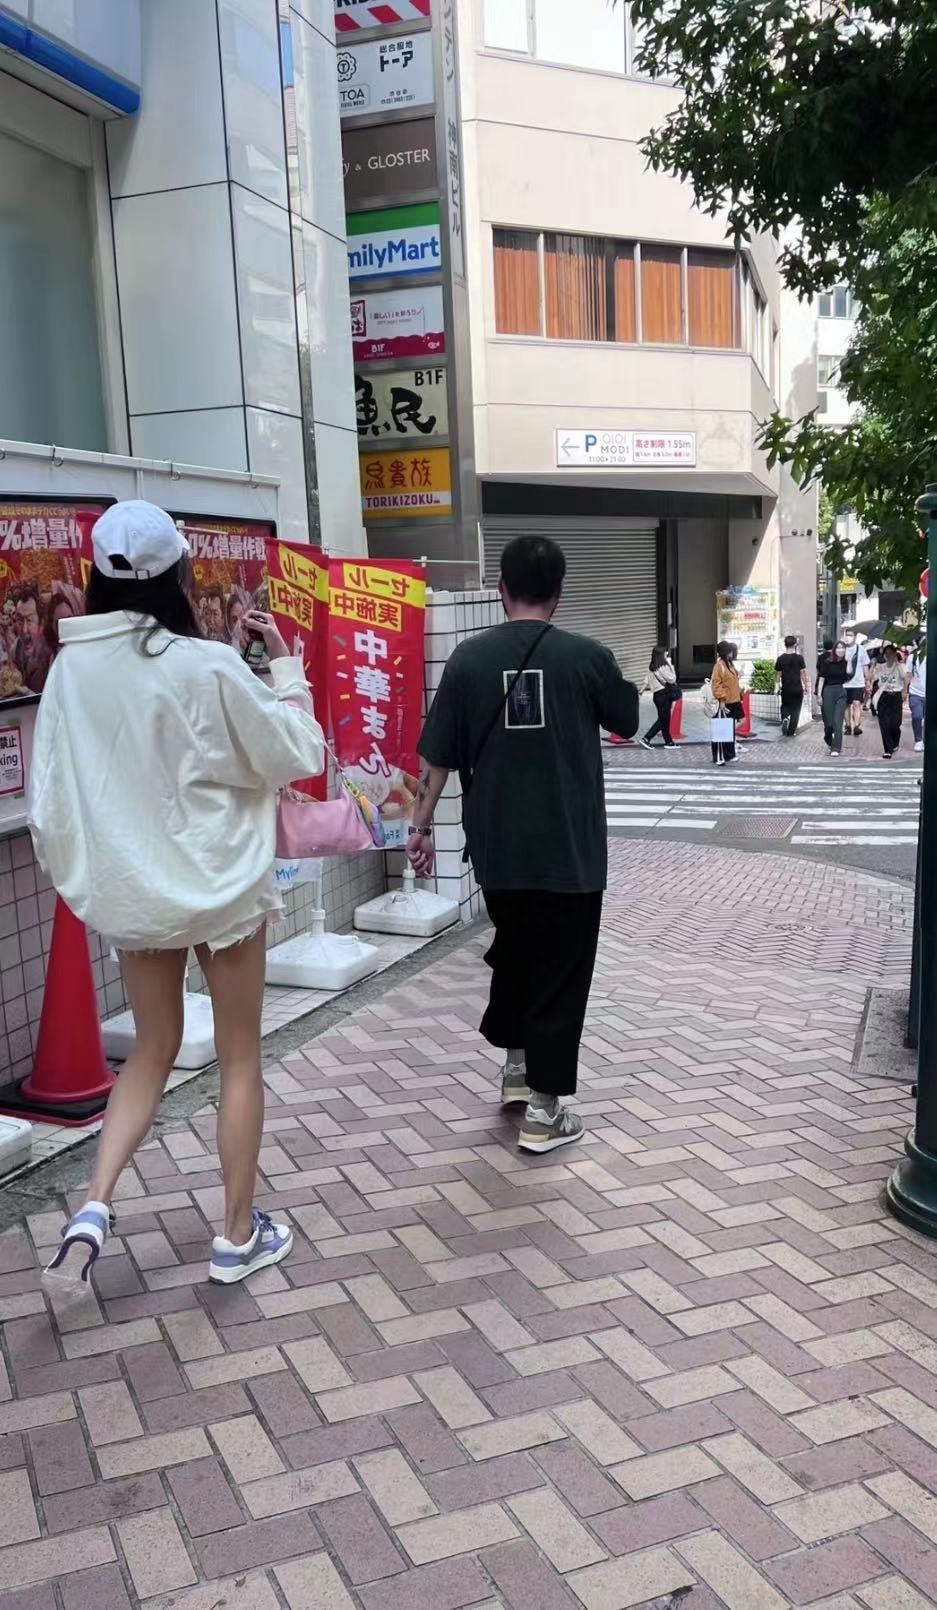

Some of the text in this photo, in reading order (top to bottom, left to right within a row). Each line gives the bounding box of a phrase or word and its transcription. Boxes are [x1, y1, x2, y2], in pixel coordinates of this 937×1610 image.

[380, 50, 414, 72] トーア
[339, 88, 365, 102] TOA
[368, 148, 431, 170] GLOSTER
[414, 369, 444, 387] B1F
[585, 434, 598, 453] P
[600, 445, 629, 455] MODI
[365, 494, 433, 508] TORIKIZOKU
